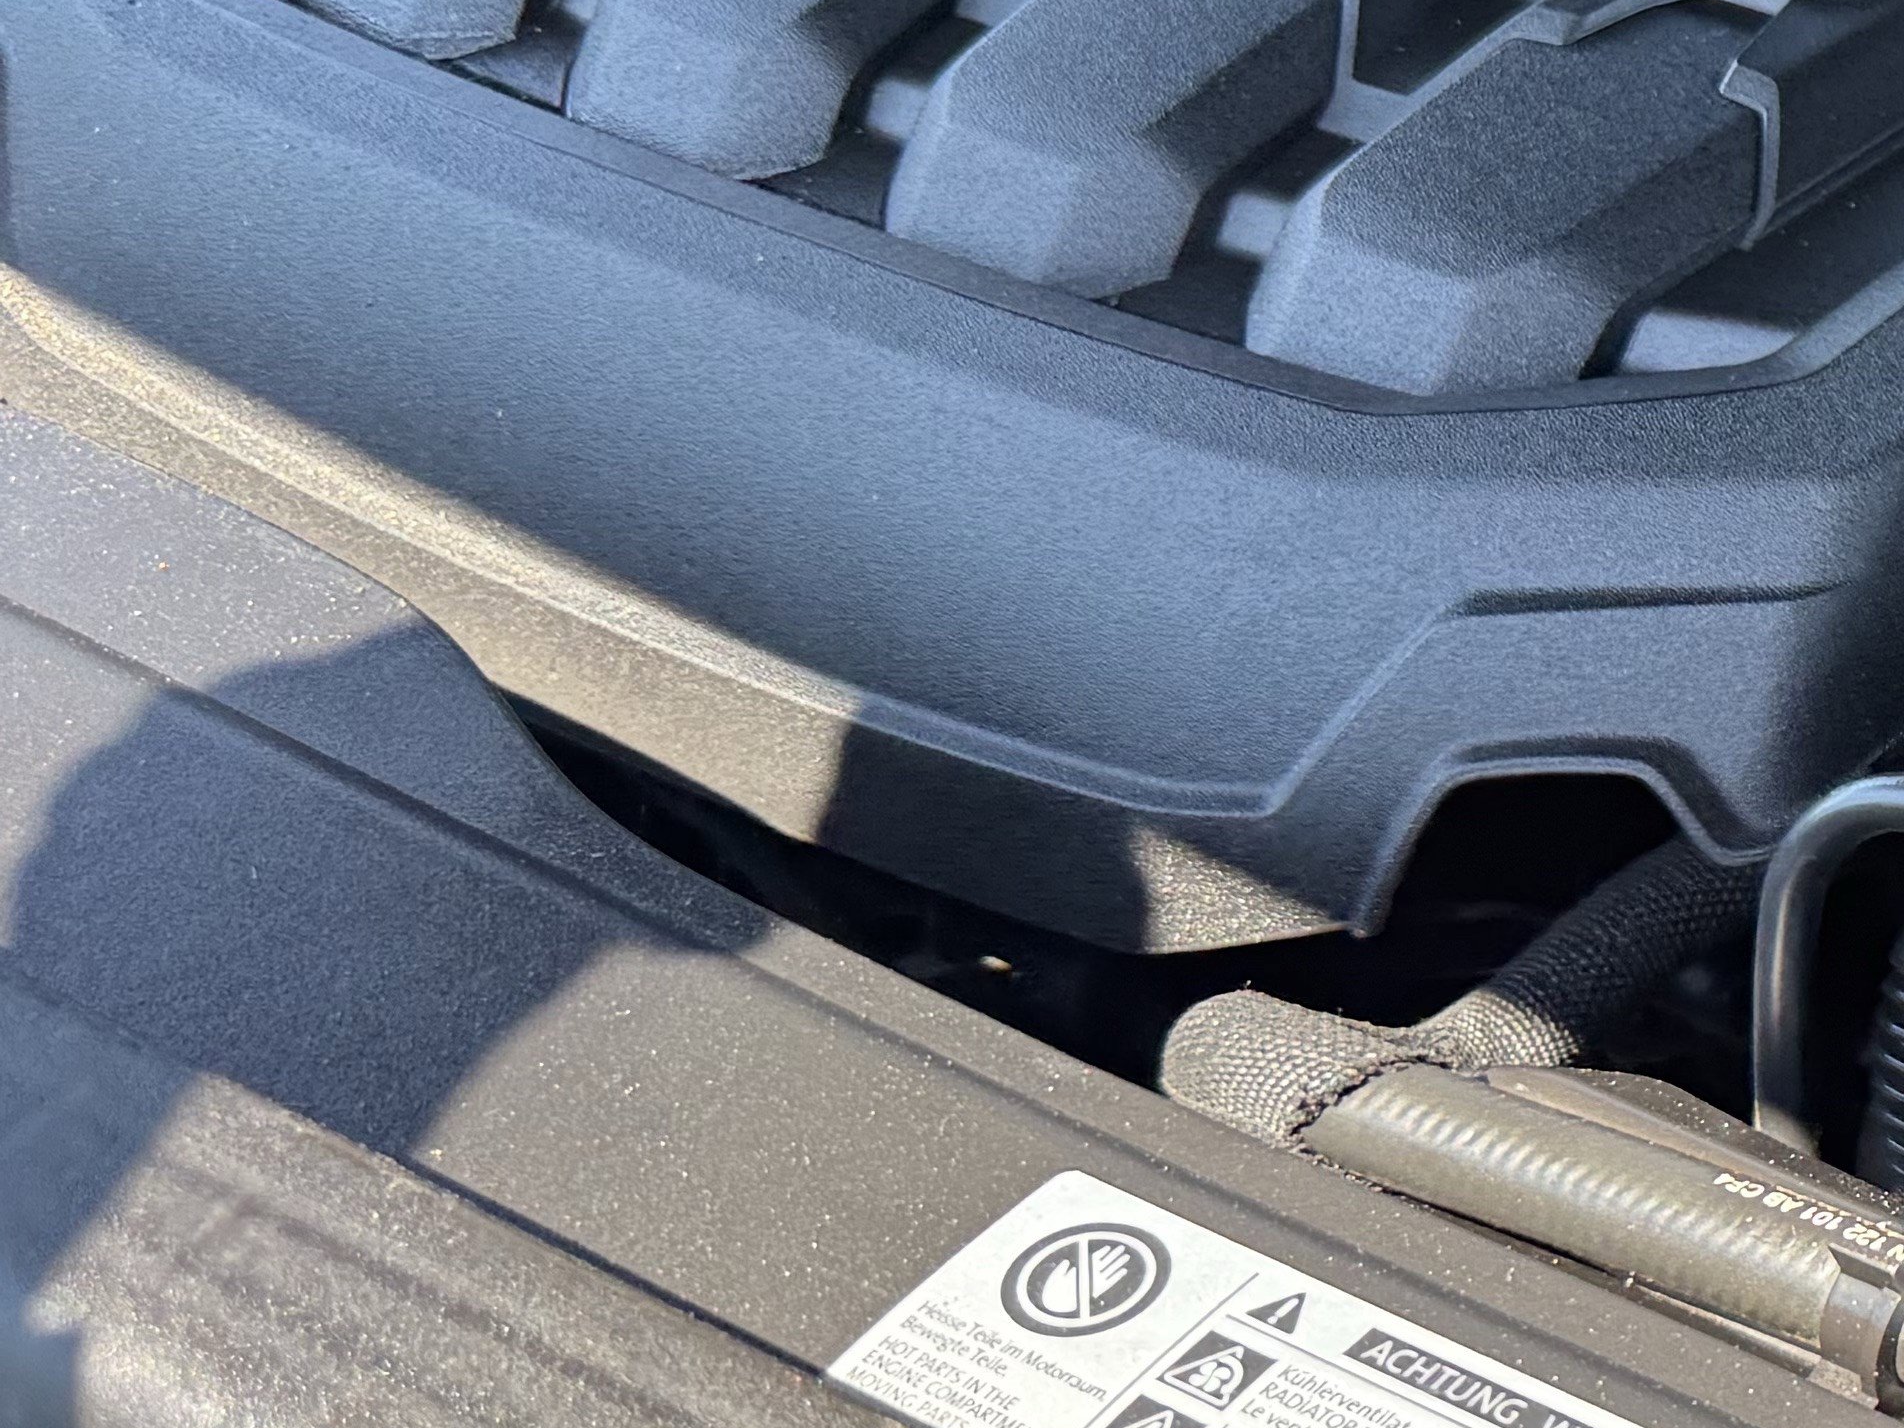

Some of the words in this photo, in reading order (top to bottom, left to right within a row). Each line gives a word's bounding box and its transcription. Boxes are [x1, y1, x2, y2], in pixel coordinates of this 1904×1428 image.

[1760, 1189, 1801, 1214] AB
[1798, 1205, 1845, 1232] 101
[1840, 1223, 1889, 1253] 122
[898, 1314, 971, 1357] Bewegte
[968, 1347, 1008, 1376] Teile.
[915, 1300, 968, 1332] Heisse
[964, 1321, 1003, 1349] Teile
[998, 1339, 1024, 1359] im
[1019, 1350, 1107, 1401] Motorraum.
[845, 1365, 918, 1408] MOVING
[860, 1349, 929, 1388] ENGINE
[876, 1335, 918, 1359] HOT
[912, 1352, 967, 1384] PARTS
[961, 1375, 988, 1394] IN
[982, 1385, 1021, 1411] THE
[1358, 1338, 1529, 1425] ACHTUNG
[1239, 1398, 1266, 1419] Le
